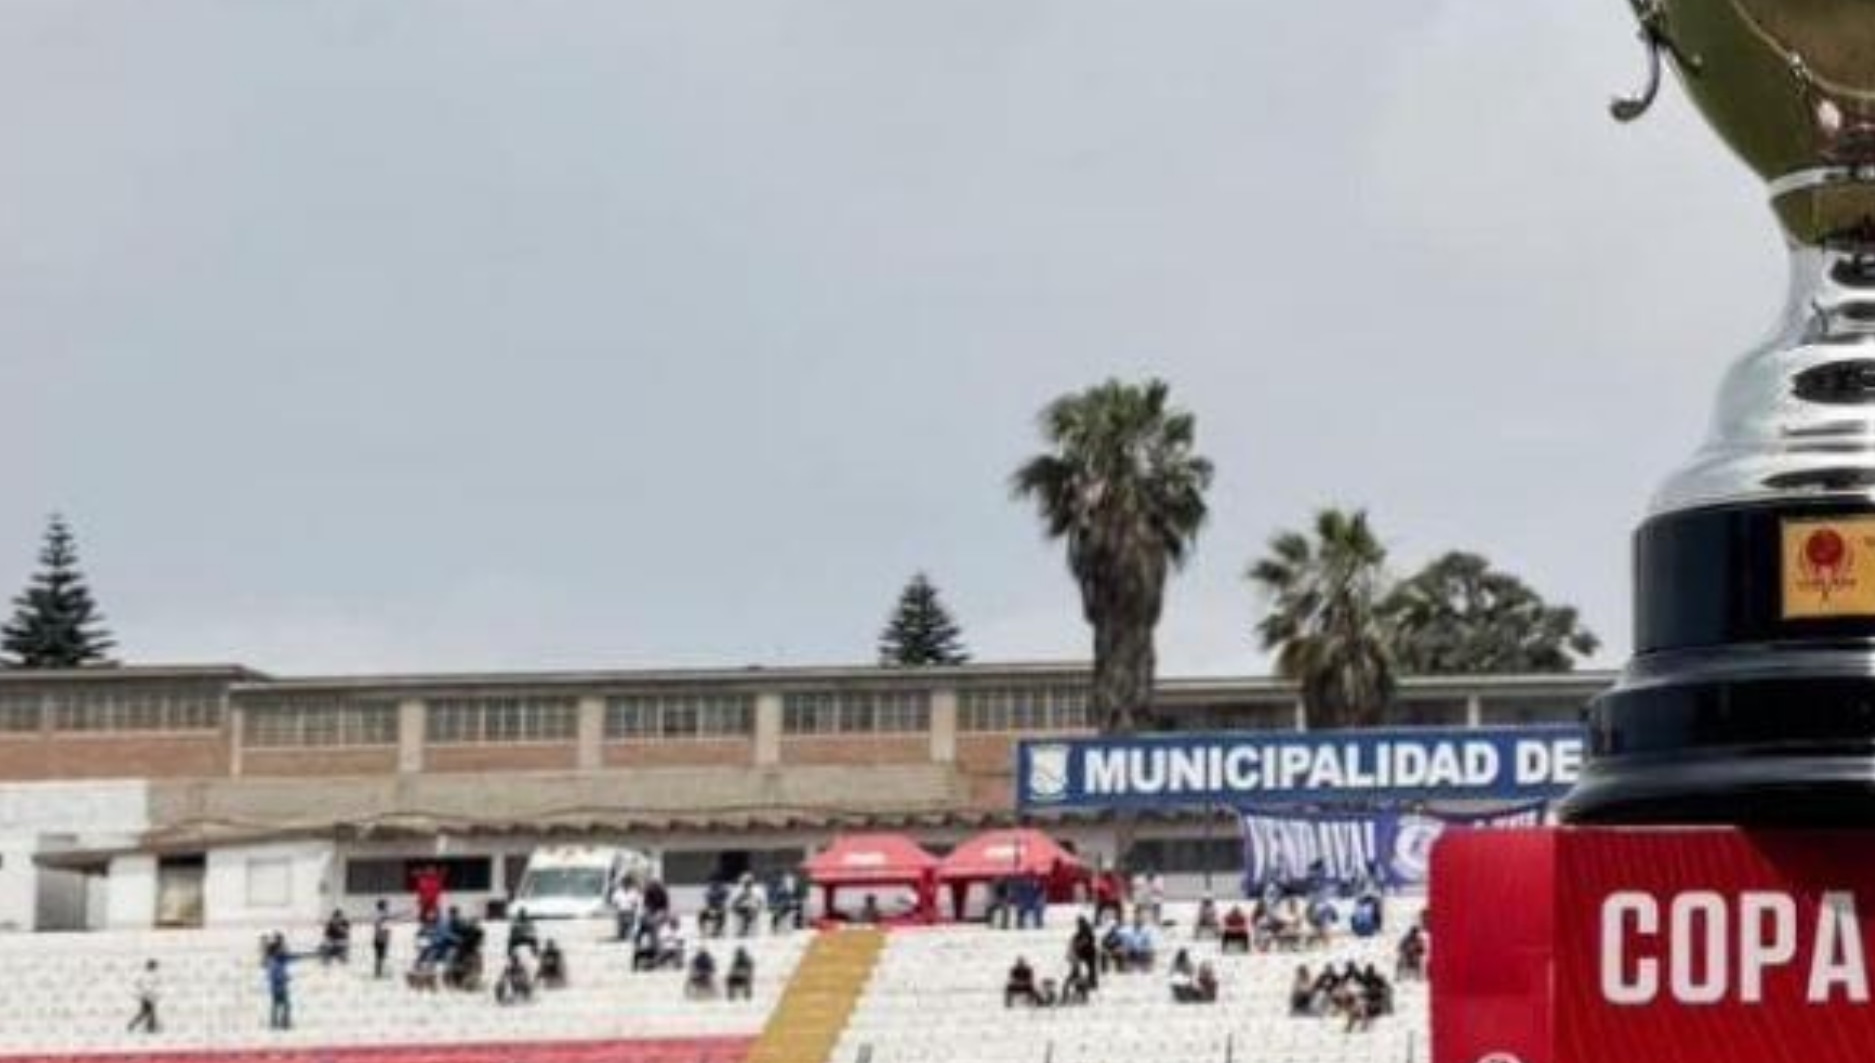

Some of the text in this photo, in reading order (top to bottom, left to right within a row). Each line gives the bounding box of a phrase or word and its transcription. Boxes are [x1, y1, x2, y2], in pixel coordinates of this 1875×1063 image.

[1084, 740, 1582, 793] MUNICIPALIDAD DE
[1601, 891, 1869, 1004] COPA
